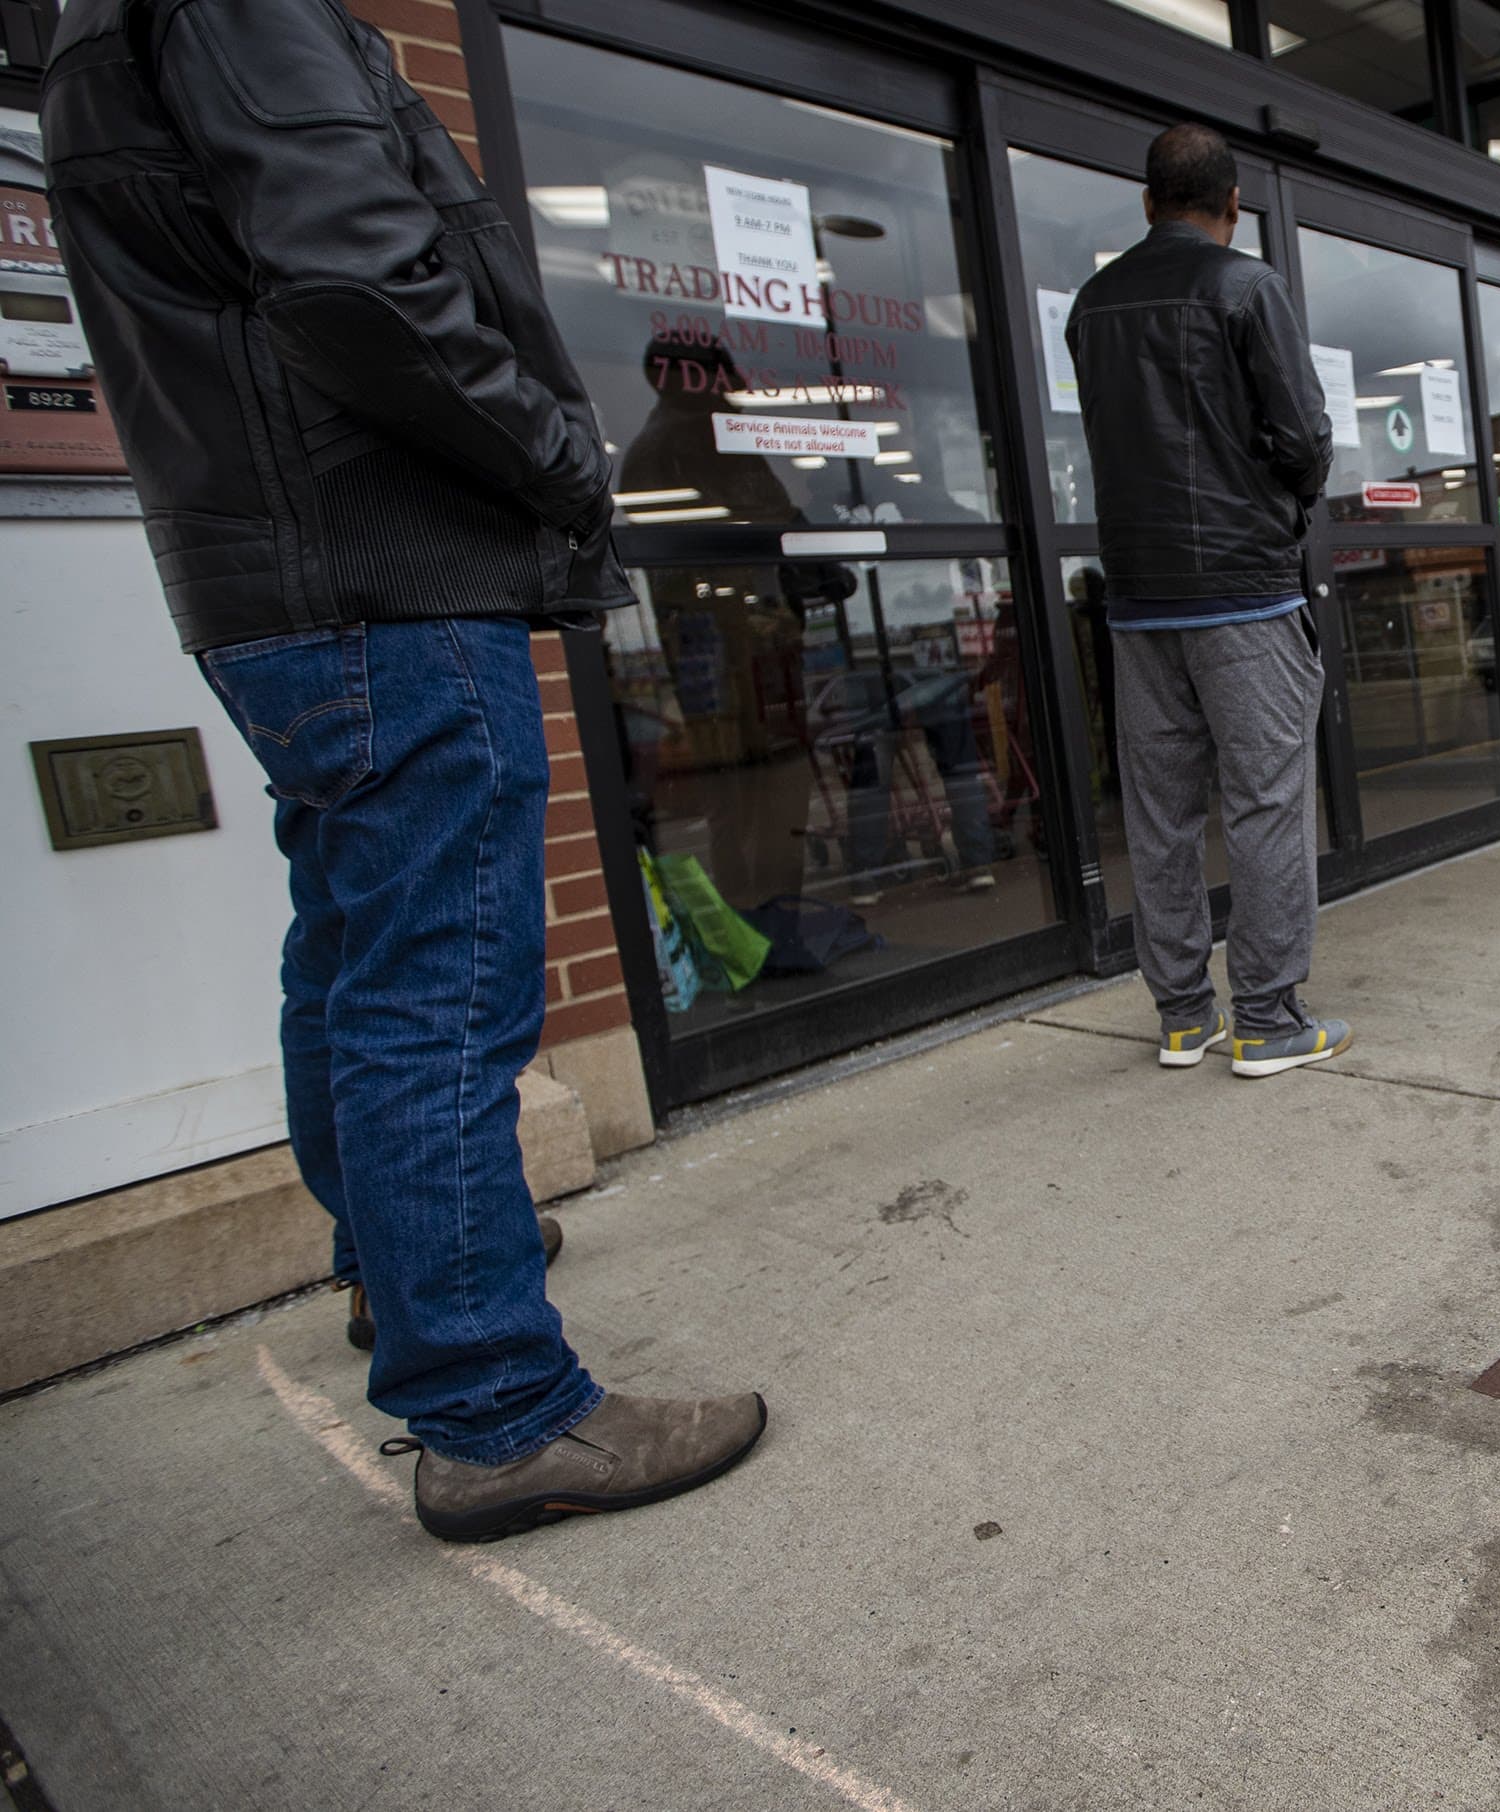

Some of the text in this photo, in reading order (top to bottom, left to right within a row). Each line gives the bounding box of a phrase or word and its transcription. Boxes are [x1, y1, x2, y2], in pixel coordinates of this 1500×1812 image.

[603, 252, 923, 332] TRADING HOURS
[653, 357, 908, 411] 7 DAYS A WEEK
[28, 392, 76, 408] 8922
[725, 419, 867, 439] Service Animals Welcome
[755, 436, 845, 451] Pets not allowed
